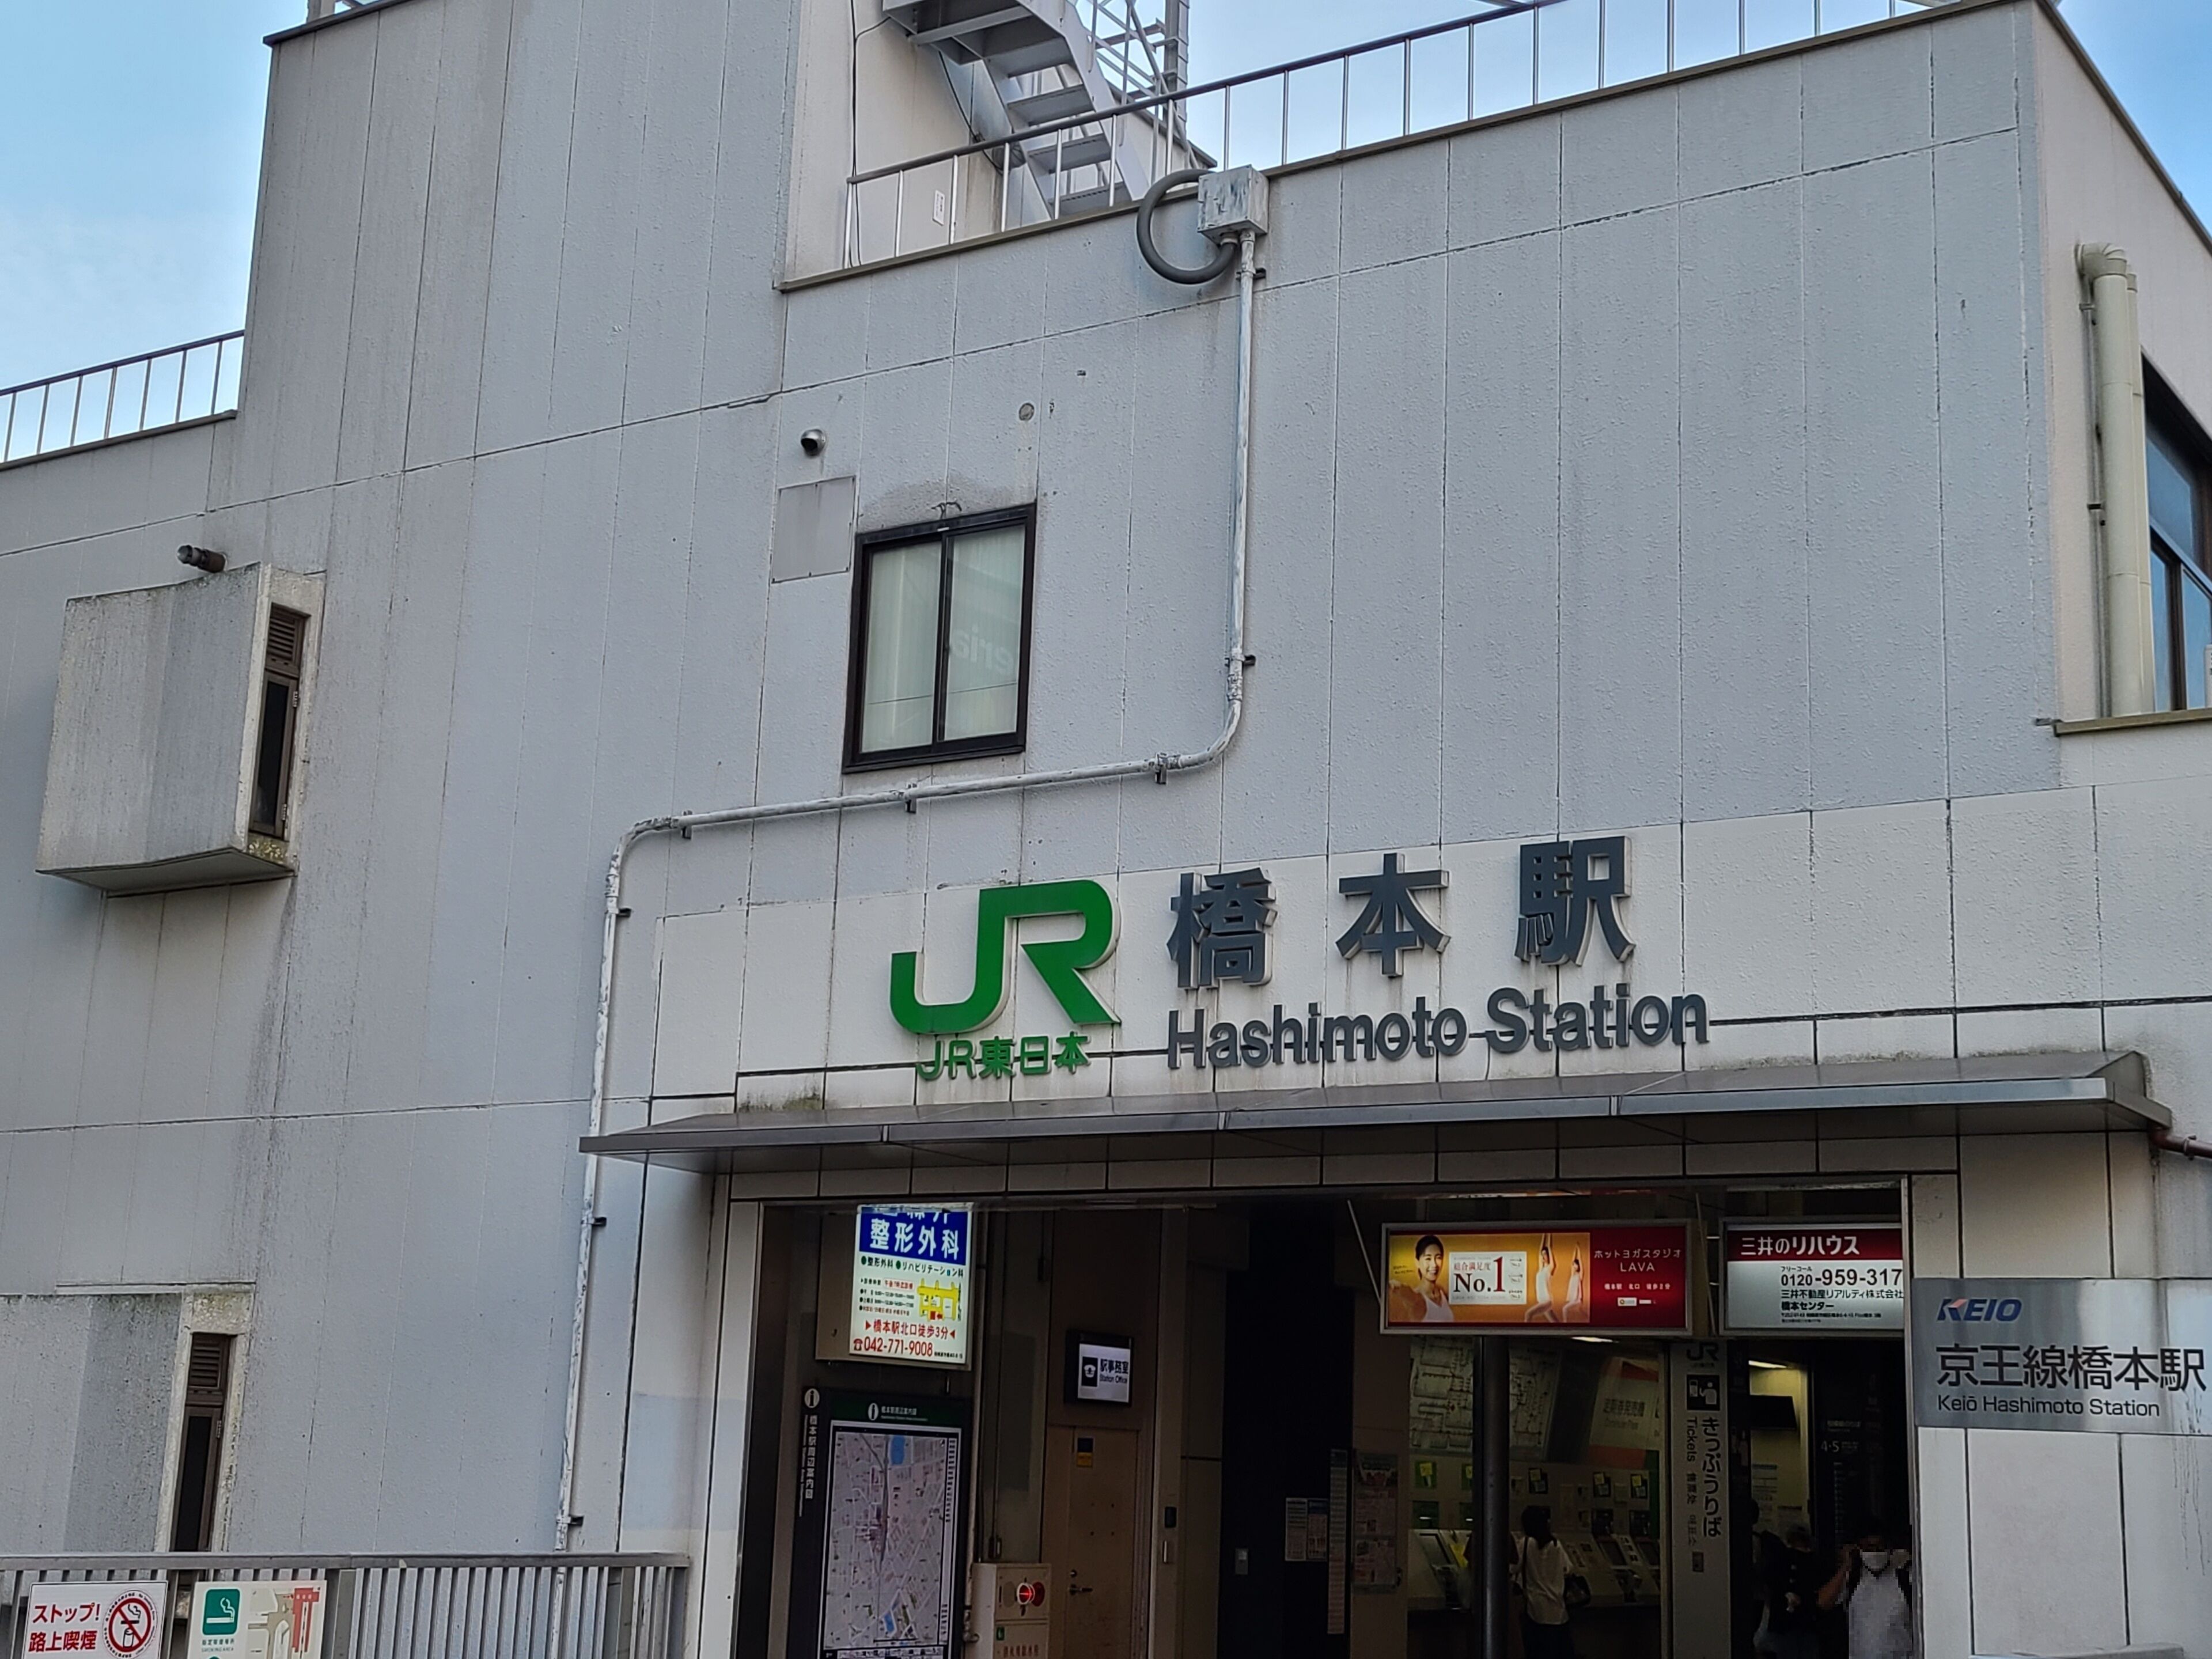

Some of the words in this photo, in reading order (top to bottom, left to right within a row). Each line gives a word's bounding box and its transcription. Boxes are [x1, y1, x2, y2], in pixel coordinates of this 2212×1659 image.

[1168, 836, 1635, 988] 橋本駅
[890, 880, 1121, 1034] JR
[1167, 997, 1467, 1070] Hashimoto
[1486, 982, 1710, 1054] Station
[916, 1031, 1091, 1081] JR東日本
[869, 1218, 960, 1261] 整形外科
[1740, 1235, 1860, 1256] 三井のリハウス
[867, 1256, 893, 1269] 整形外科
[1594, 1248, 1681, 1259] ホットヨガスタジオ
[1453, 1256, 1506, 1293] No.1
[1620, 1262, 1656, 1272] LAVA
[1781, 1268, 1903, 1286] 0120-959-317
[1781, 1289, 1904, 1299] 三井不動産リアルティ株式会社
[1781, 1301, 1835, 1311] 橋本センター
[1937, 1298, 2022, 1321] KEIO
[873, 1319, 949, 1340] 橋本駅北口徒歩3分
[864, 1336, 933, 1357] 042-771-9008
[1687, 1342, 1719, 1361] JR
[1100, 1358, 1129, 1374] 駅事務室
[1936, 1343, 2207, 1392] 京王線橋本駅
[1937, 1395, 1978, 1412] Keiō
[1983, 1396, 2084, 1414] Hashimoto
[2089, 1398, 2160, 1416] Station
[1687, 1416, 1698, 1462] Tickets
[1702, 1417, 1722, 1537] きっぷうりば
[32, 1602, 101, 1623] ストップ!
[28, 1630, 97, 1653] 路上喫煙
